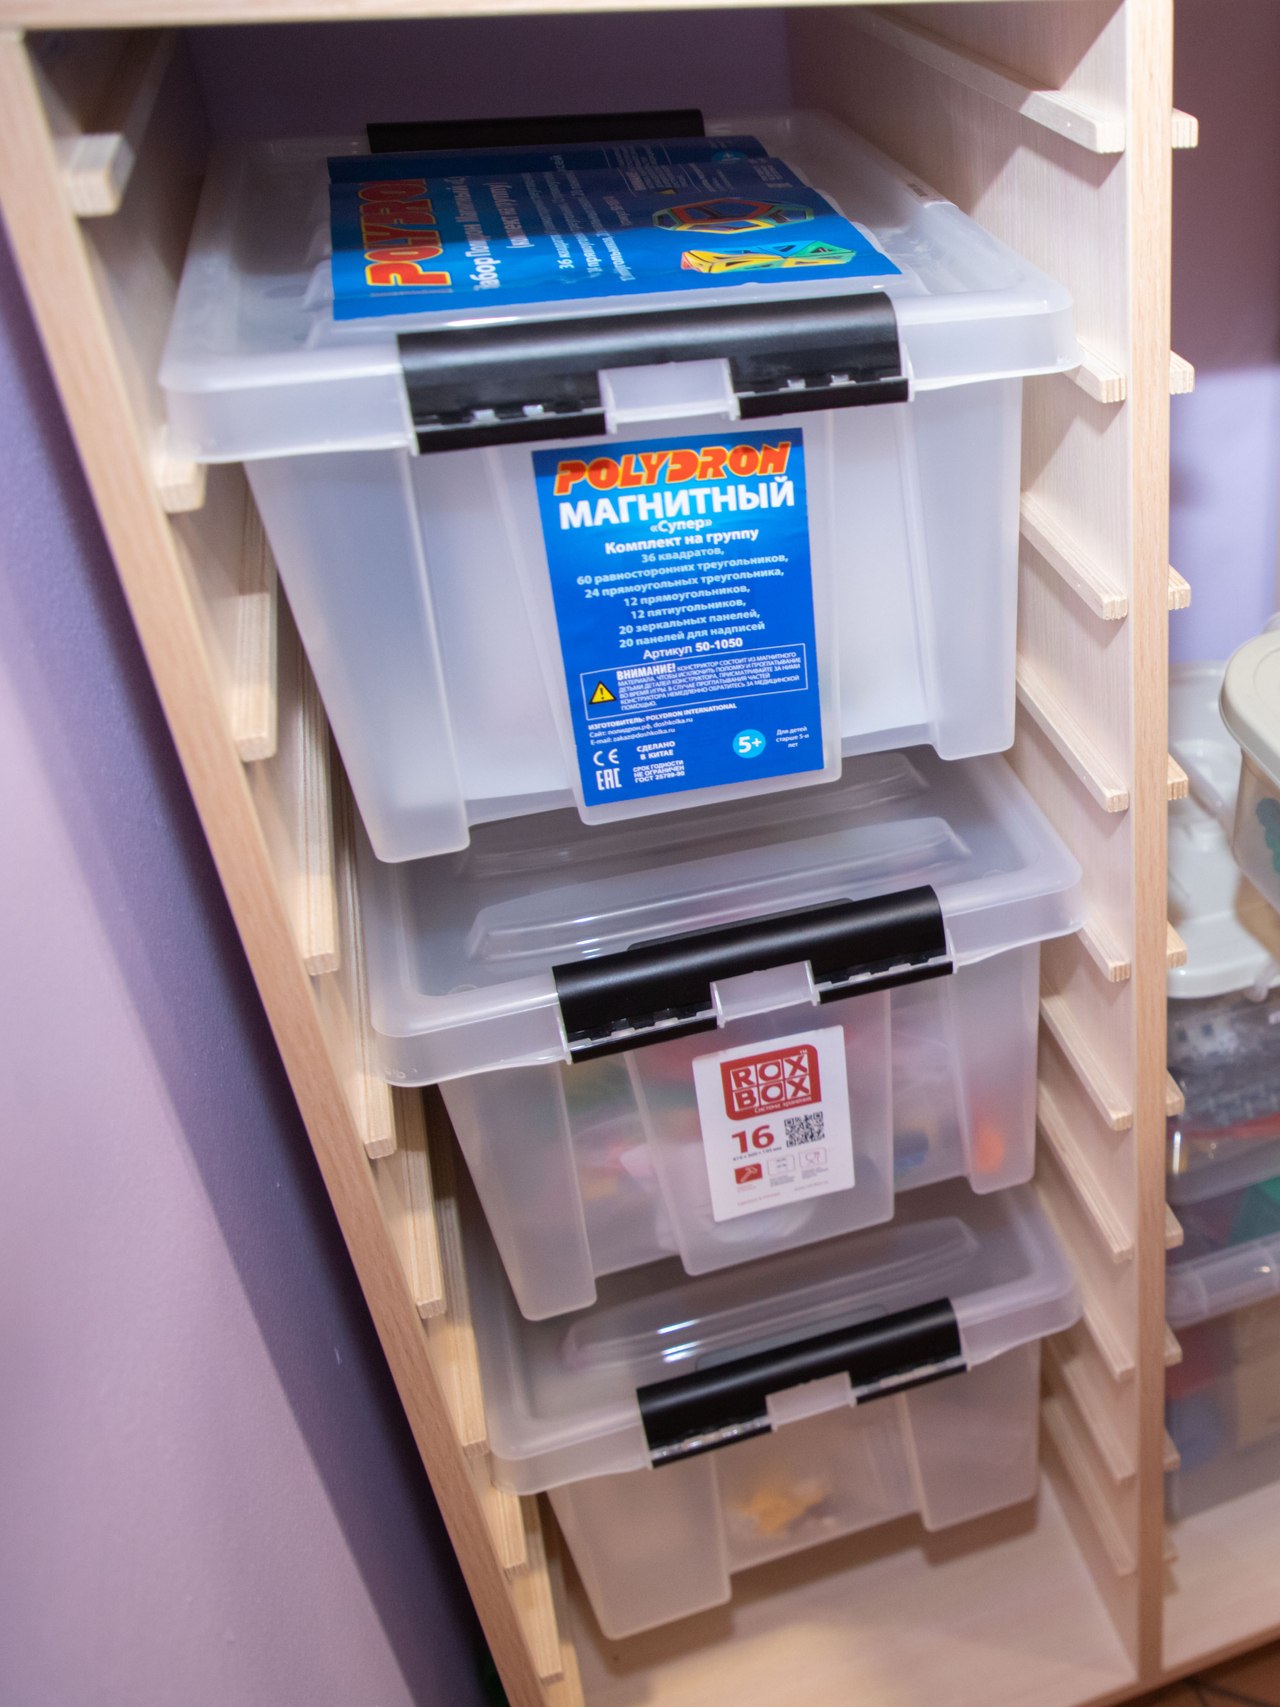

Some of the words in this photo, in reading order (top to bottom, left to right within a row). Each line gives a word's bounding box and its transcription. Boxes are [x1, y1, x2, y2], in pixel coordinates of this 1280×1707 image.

[554, 442, 790, 495] POLYDRON
[559, 476, 794, 528] МАГНИТНЫЙ
[650, 518, 712, 533] «Супер»
[605, 536, 681, 554] Комплект
[684, 534, 703, 544] на
[706, 529, 758, 544] группу
[641, 553, 656, 563] 36
[658, 547, 724, 560] квадратов,
[576, 575, 592, 585] 60
[594, 564, 694, 585] равносторонних
[697, 555, 788, 571] треугольников,
[584, 588, 599, 598] 24
[602, 577, 698, 597] прямоугольных
[701, 568, 784, 584] треугольника,
[624, 597, 637, 606] 12
[640, 585, 750, 605] прямоугольников,
[631, 609, 645, 619] 12
[647, 599, 745, 616] пятиугольников,
[619, 625, 633, 634] 20
[636, 616, 706, 632] зеркальных
[709, 609, 760, 622] панелей,
[619, 638, 633, 648] 20
[635, 631, 684, 645] панелей
[686, 629, 708, 640] для
[710, 621, 765, 635] надписей
[643, 645, 692, 660] Артикул
[695, 637, 743, 652] 50-1050
[616, 663, 675, 680] ВНИМАНИЕ!
[719, 657, 747, 666] СОСТОИТ
[756, 652, 796, 661] МАГНИТНОГО
[588, 717, 645, 730] ИЗГОТОВИТЕЛЬ:
[645, 710, 683, 721] POLYDRON
[683, 703, 736, 715] INTERNATIONAL
[653, 718, 693, 727] doshkolka.ru
[590, 737, 612, 745] E-mail:
[789, 726, 807, 734] детей
[636, 740, 675, 752] СДЕЛАНО
[648, 749, 673, 758] КИТАЕ
[738, 735, 761, 753] 5+
[644, 765, 684, 776] ОГРАНИЧЕН
[650, 760, 683, 769] ГОДНОСТИ
[732, 1055, 808, 1088] ROX
[735, 1077, 810, 1110] BOX
[732, 1125, 774, 1153] 16
